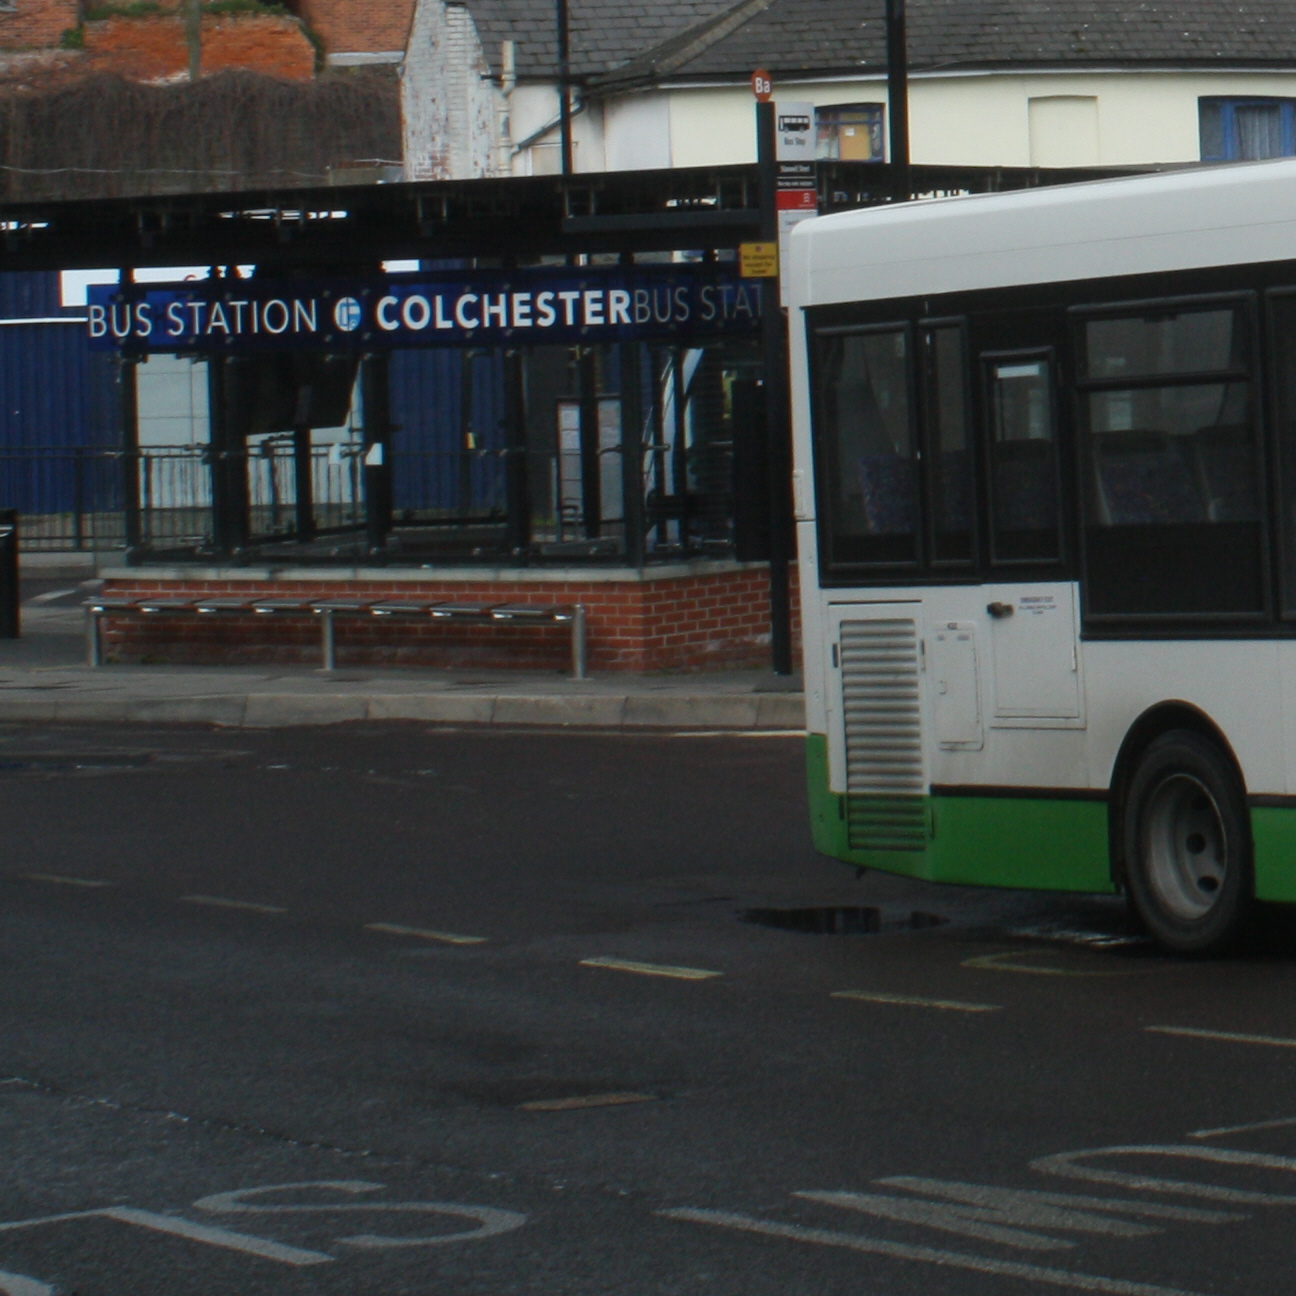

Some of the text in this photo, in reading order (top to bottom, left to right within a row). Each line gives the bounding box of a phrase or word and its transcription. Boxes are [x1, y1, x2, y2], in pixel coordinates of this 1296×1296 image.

[755, 77, 771, 94] Ba
[89, 299, 317, 338] BUS STATION
[376, 289, 632, 331] COLCHESTER
[634, 287, 690, 324] BUS
